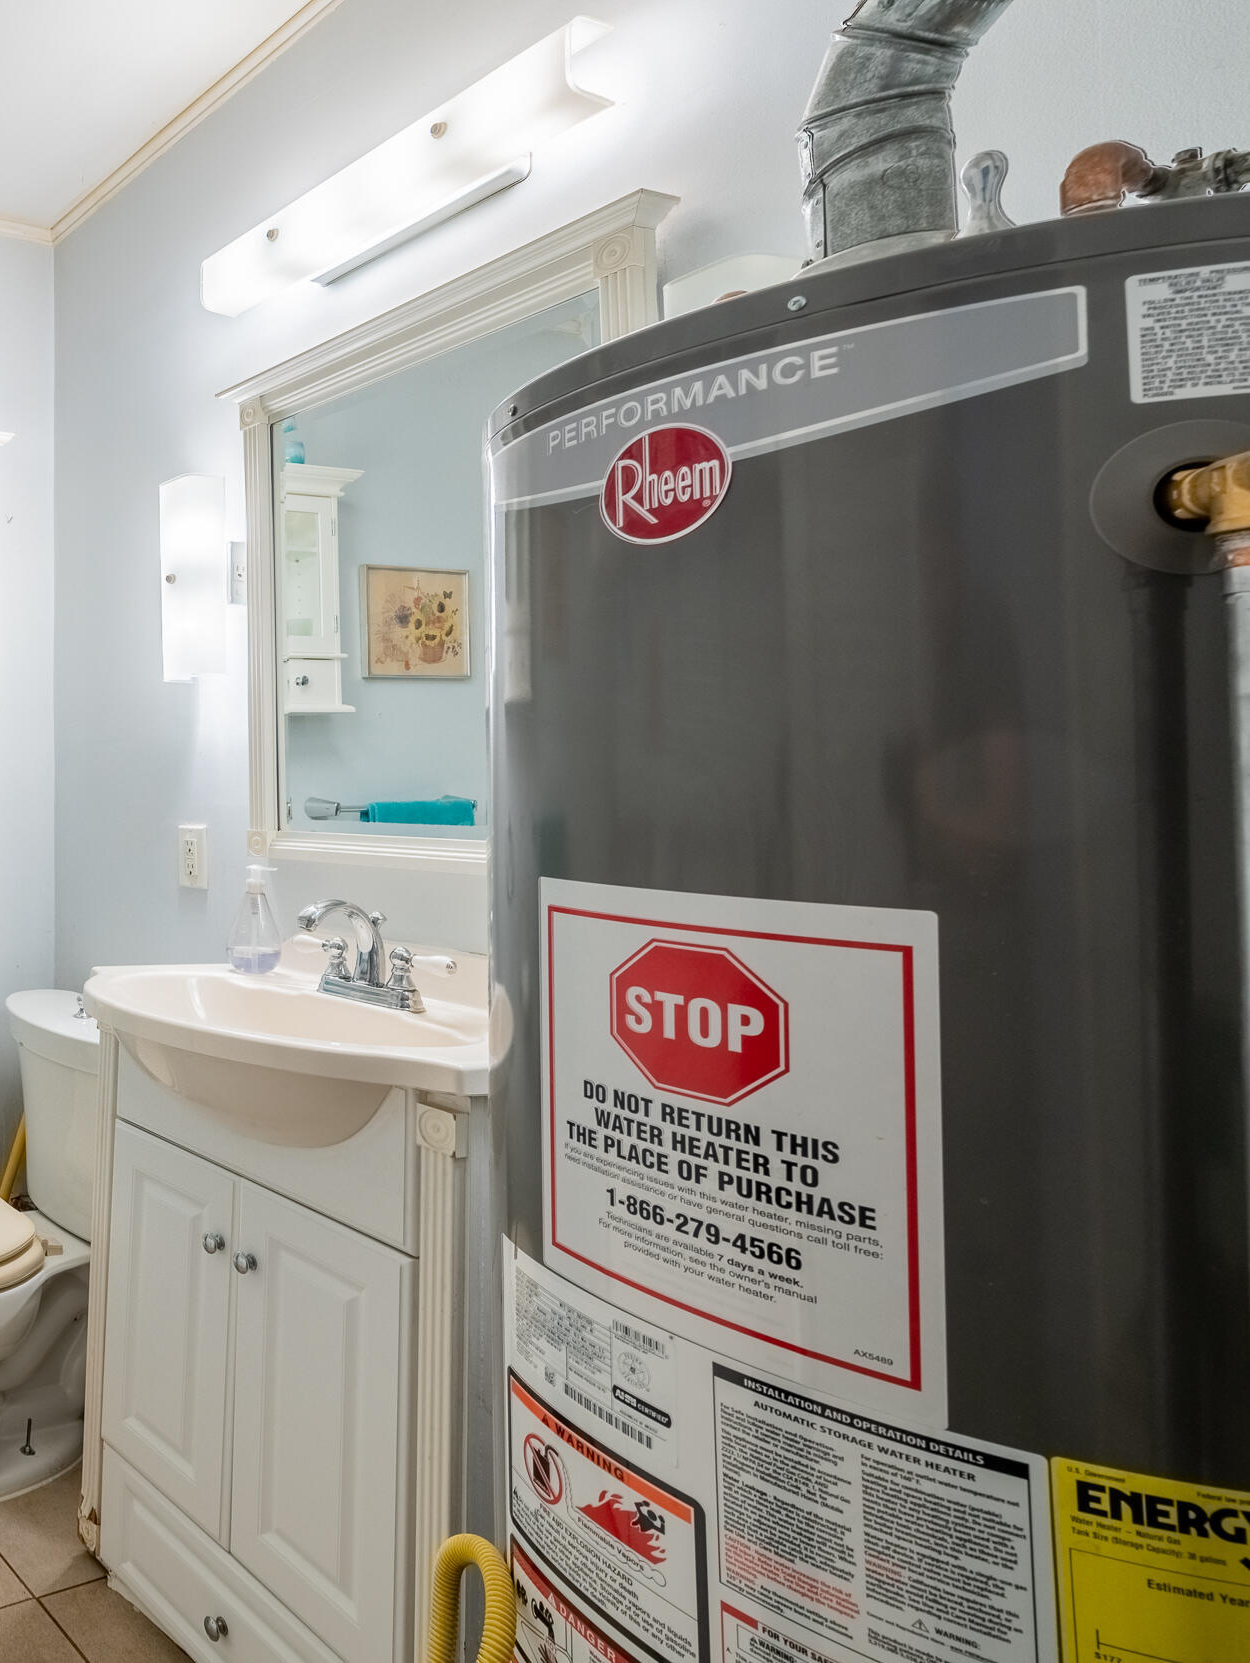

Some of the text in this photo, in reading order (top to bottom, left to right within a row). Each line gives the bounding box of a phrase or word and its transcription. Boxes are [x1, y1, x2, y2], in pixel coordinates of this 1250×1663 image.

[546, 346, 841, 455] PERFORMANCE
[614, 432, 720, 528] Rheem
[625, 984, 765, 1053] STOP
[583, 1079, 840, 1164] DO NOT RETURN THIS
[594, 1107, 819, 1188] WATER HEATER TO
[564, 1142, 883, 1249] If you are experiencing issues with this water heater, missing parts,
[564, 1153, 884, 1260] need installation assistance or have general questions call toll free:
[566, 1120, 877, 1231] THE PLACE OF PURCHASE
[598, 1218, 818, 1304] For more information, see the owner's manual
[606, 1188, 803, 1271] 1-866-279-4566
[606, 1211, 804, 1289] Technicians are available 7 days a week.
[623, 1241, 777, 1303] provided with your water heater.
[853, 1348, 894, 1366] AX5489
[554, 1421, 625, 1482] WARNING
[743, 1378, 985, 1465] INSTALLATION AND OPERATION DETAILS
[753, 1400, 976, 1482] AUTOMATIC STORAGE WATER HEATER
[539, 1503, 633, 1587] FIRE AND EXPLOSION HAZARD
[577, 1516, 615, 1550] Flammable
[616, 1547, 644, 1571] Vapors
[1075, 1479, 1250, 1545] ENERG
[1147, 1578, 1214, 1602] Estimated
[559, 1603, 616, 1663] DANGER
[762, 1626, 780, 1642] FOR
[782, 1637, 809, 1656] YOUR
